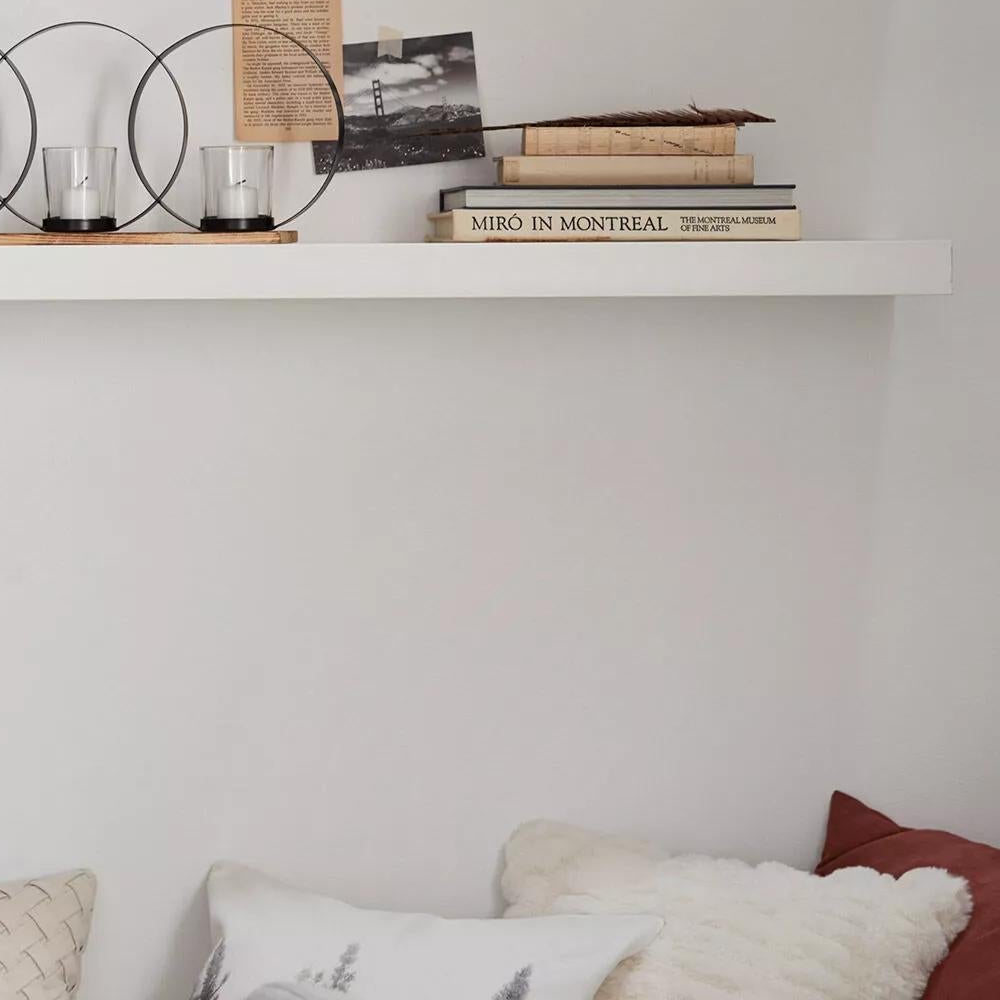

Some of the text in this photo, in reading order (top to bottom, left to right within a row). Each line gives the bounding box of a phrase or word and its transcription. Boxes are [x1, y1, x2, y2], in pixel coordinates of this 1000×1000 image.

[471, 213, 669, 231] MIRÓ IN MONTREAL
[680, 216, 777, 225] THE MONTREAL MUSEUM
